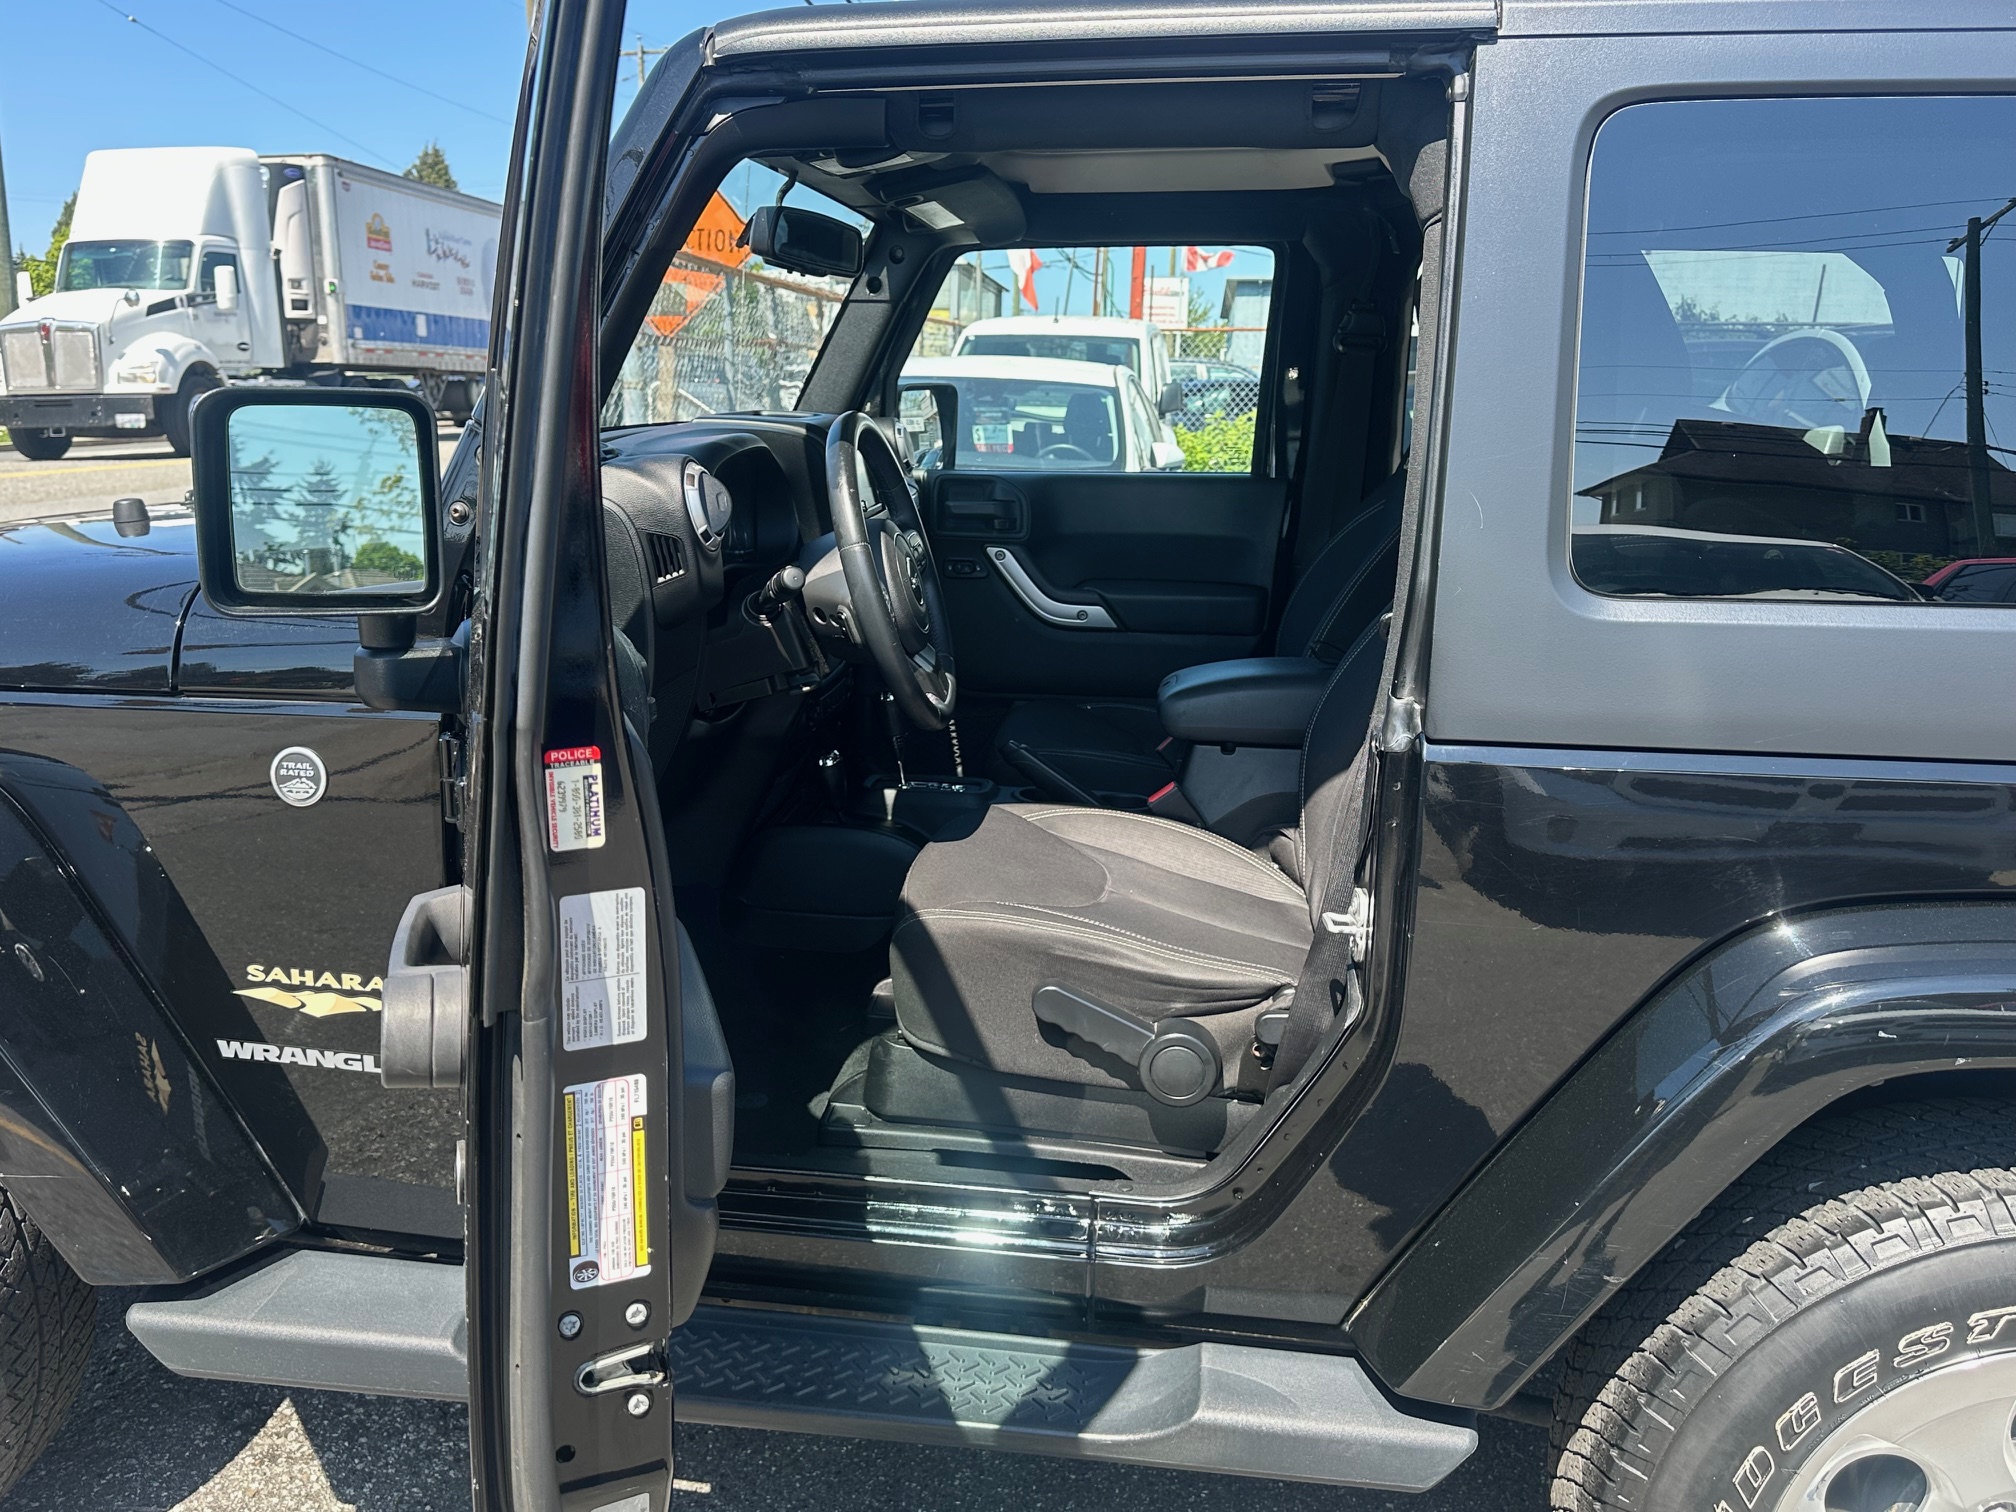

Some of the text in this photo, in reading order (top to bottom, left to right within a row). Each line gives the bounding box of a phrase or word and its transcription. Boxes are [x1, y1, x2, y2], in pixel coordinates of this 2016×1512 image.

[550, 758, 594, 769] TRACEABLE
[551, 749, 592, 761] POLICE
[280, 769, 314, 777] RATED
[282, 762, 313, 770] TRAIL
[589, 774, 601, 836] PLATINUM
[246, 965, 383, 992] SAHARA
[216, 1039, 382, 1074] WRANGL
[1713, 1305, 2016, 1512] DGEST
